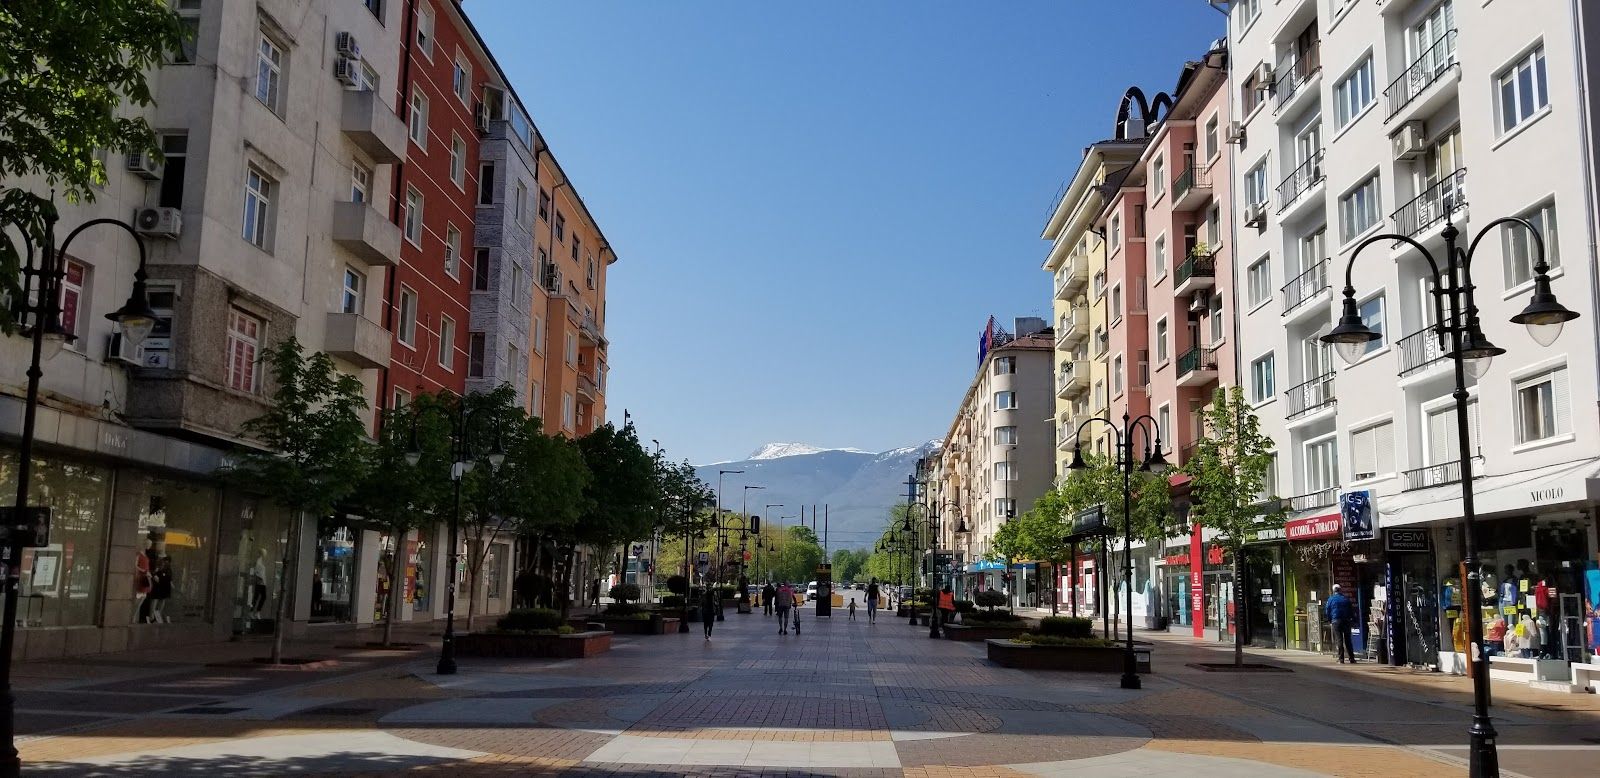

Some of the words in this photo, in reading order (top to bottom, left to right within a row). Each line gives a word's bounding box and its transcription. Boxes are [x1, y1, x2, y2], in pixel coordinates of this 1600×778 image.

[1530, 487, 1564, 503] NICOLO
[1314, 519, 1339, 534] TOBACCO
[1391, 532, 1425, 542] GSM
